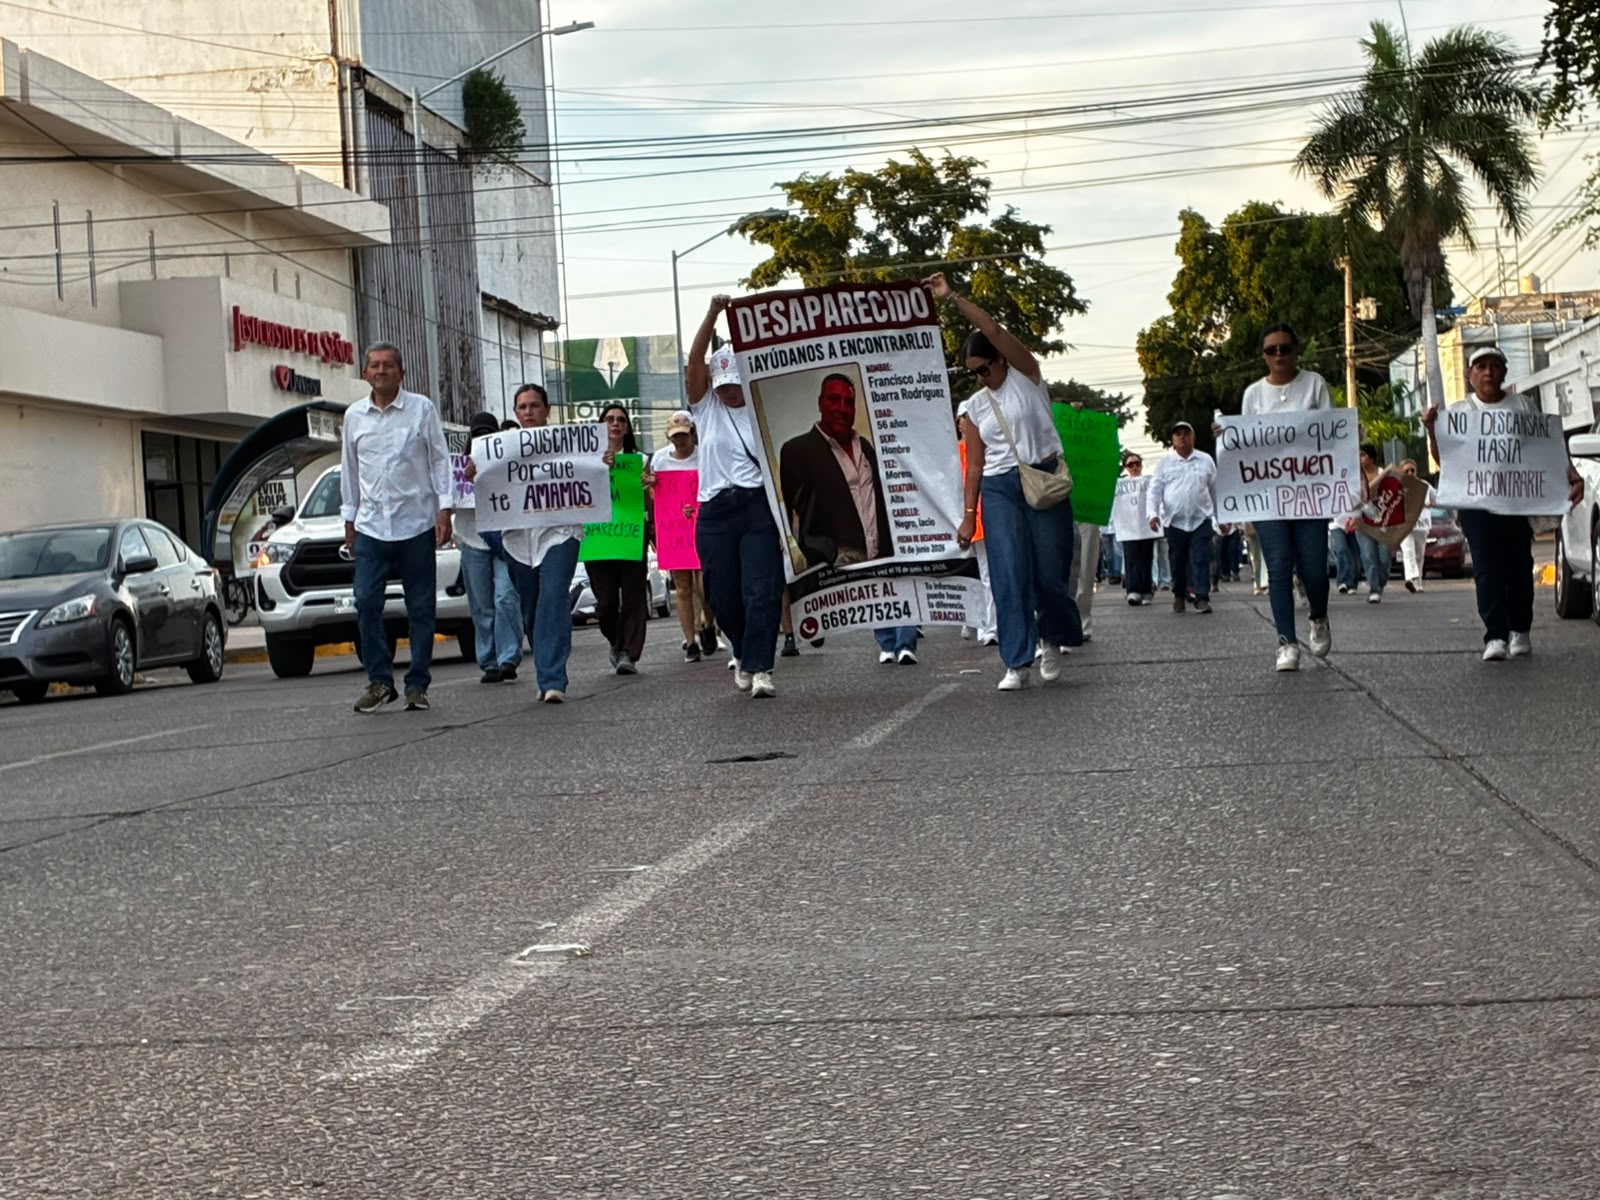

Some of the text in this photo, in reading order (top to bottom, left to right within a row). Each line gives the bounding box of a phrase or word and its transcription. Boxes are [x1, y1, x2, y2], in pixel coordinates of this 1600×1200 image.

[735, 286, 930, 343] DESAPARECIDO
[320, 331, 354, 365] SEÑOR
[748, 331, 935, 374] ¡AYÚDANOS A ENCONTRARLO!
[868, 371, 942, 388] Francisco Javier
[870, 391, 900, 403] Ibarra
[877, 419, 908, 429] 56 años
[1222, 418, 1349, 452] Quiero que
[1447, 412, 1468, 435] NO
[482, 425, 599, 460] Te BUSCAMOS
[881, 445, 911, 455] Hombre
[1477, 438, 1522, 464] HASTA
[507, 460, 575, 482] Porque
[883, 460, 897, 469] TEZ:
[1239, 453, 1334, 484] busquen
[489, 481, 592, 512] te AMAMOS
[1223, 495, 1239, 512] a
[1245, 490, 1270, 512] mi
[1276, 468, 1356, 517] PAPÁ
[1467, 469, 1547, 498] ENCONTRARTE
[257, 493, 288, 507] GOLPE
[907, 546, 915, 554] de
[804, 581, 898, 614] COMUNÍCATE AL
[926, 591, 945, 601] puede
[820, 600, 912, 630] 6682275254
